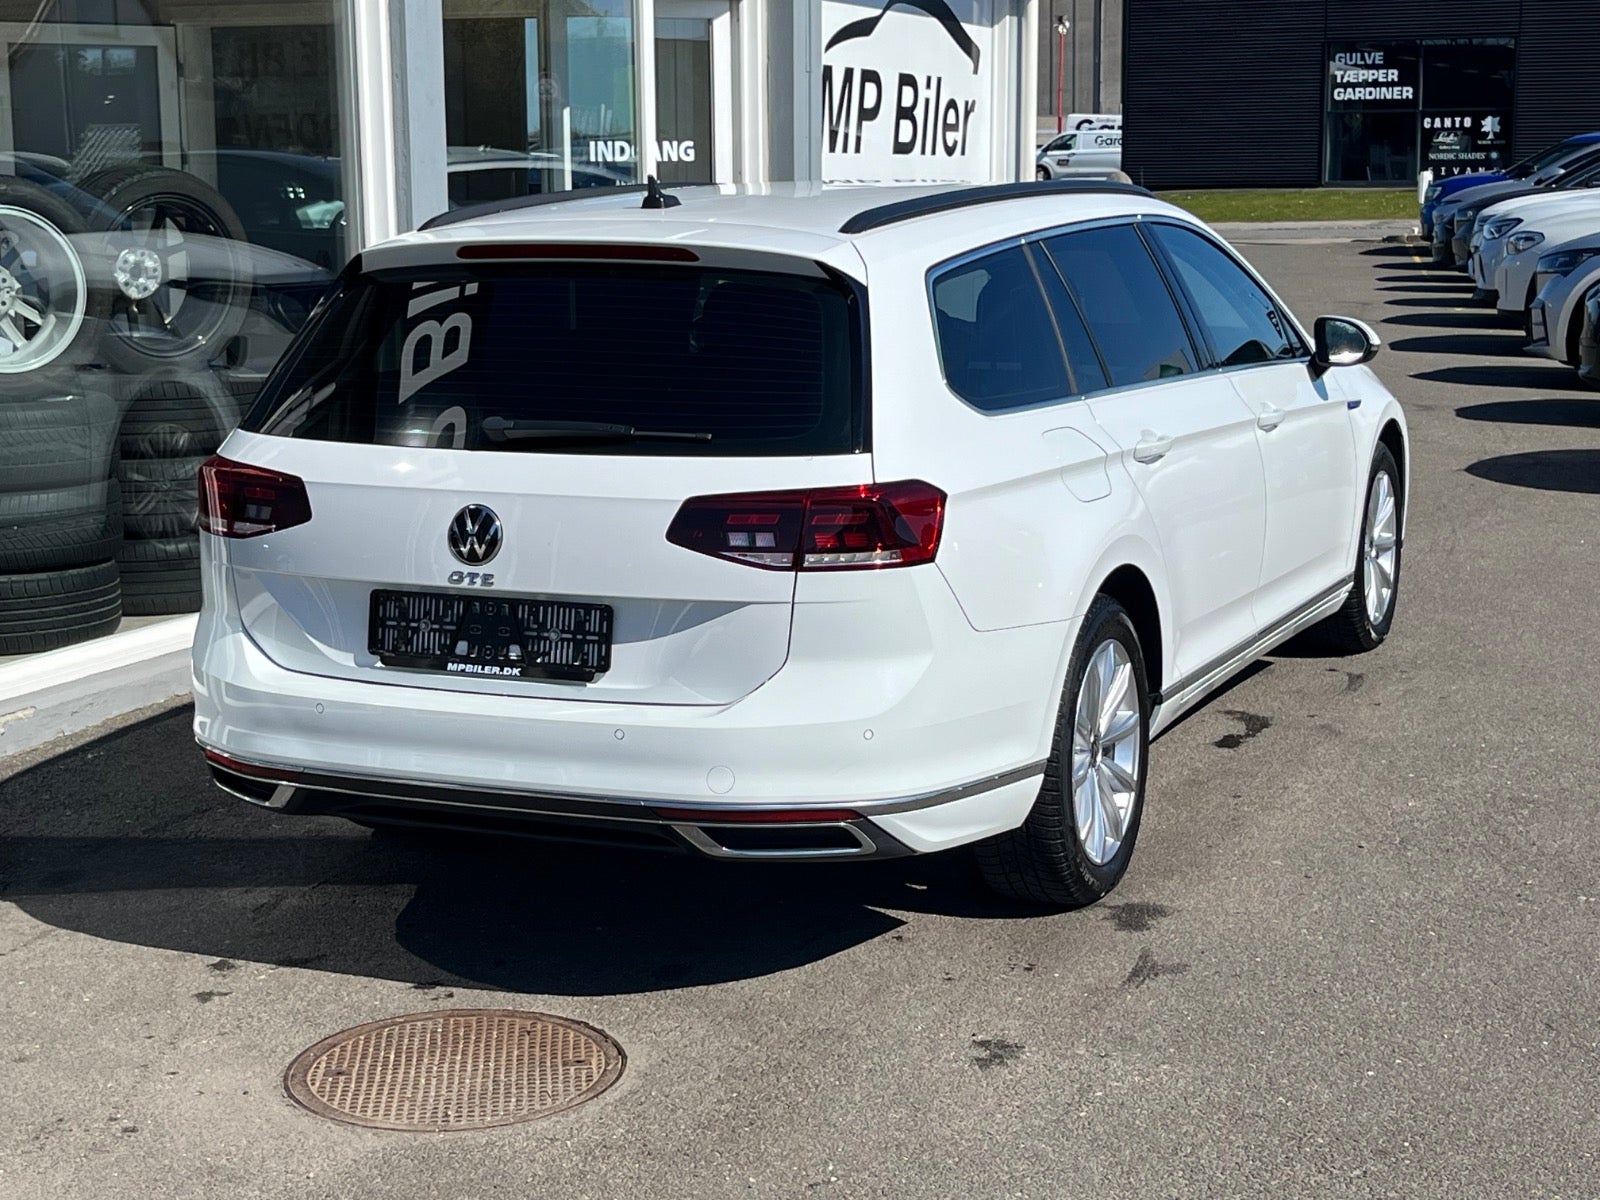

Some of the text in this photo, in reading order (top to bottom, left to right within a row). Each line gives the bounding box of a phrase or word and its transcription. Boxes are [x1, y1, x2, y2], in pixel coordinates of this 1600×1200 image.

[1335, 52, 1384, 65] GULVE
[1335, 69, 1398, 83] TÆPPER
[1333, 87, 1413, 101] GARDINER
[892, 72, 976, 157] Biler
[1423, 117, 1472, 129] CANTO
[1428, 152, 1486, 160] NORDIC SHADES
[447, 570, 494, 587] GTE
[446, 662, 522, 677] MPBILER.DK
